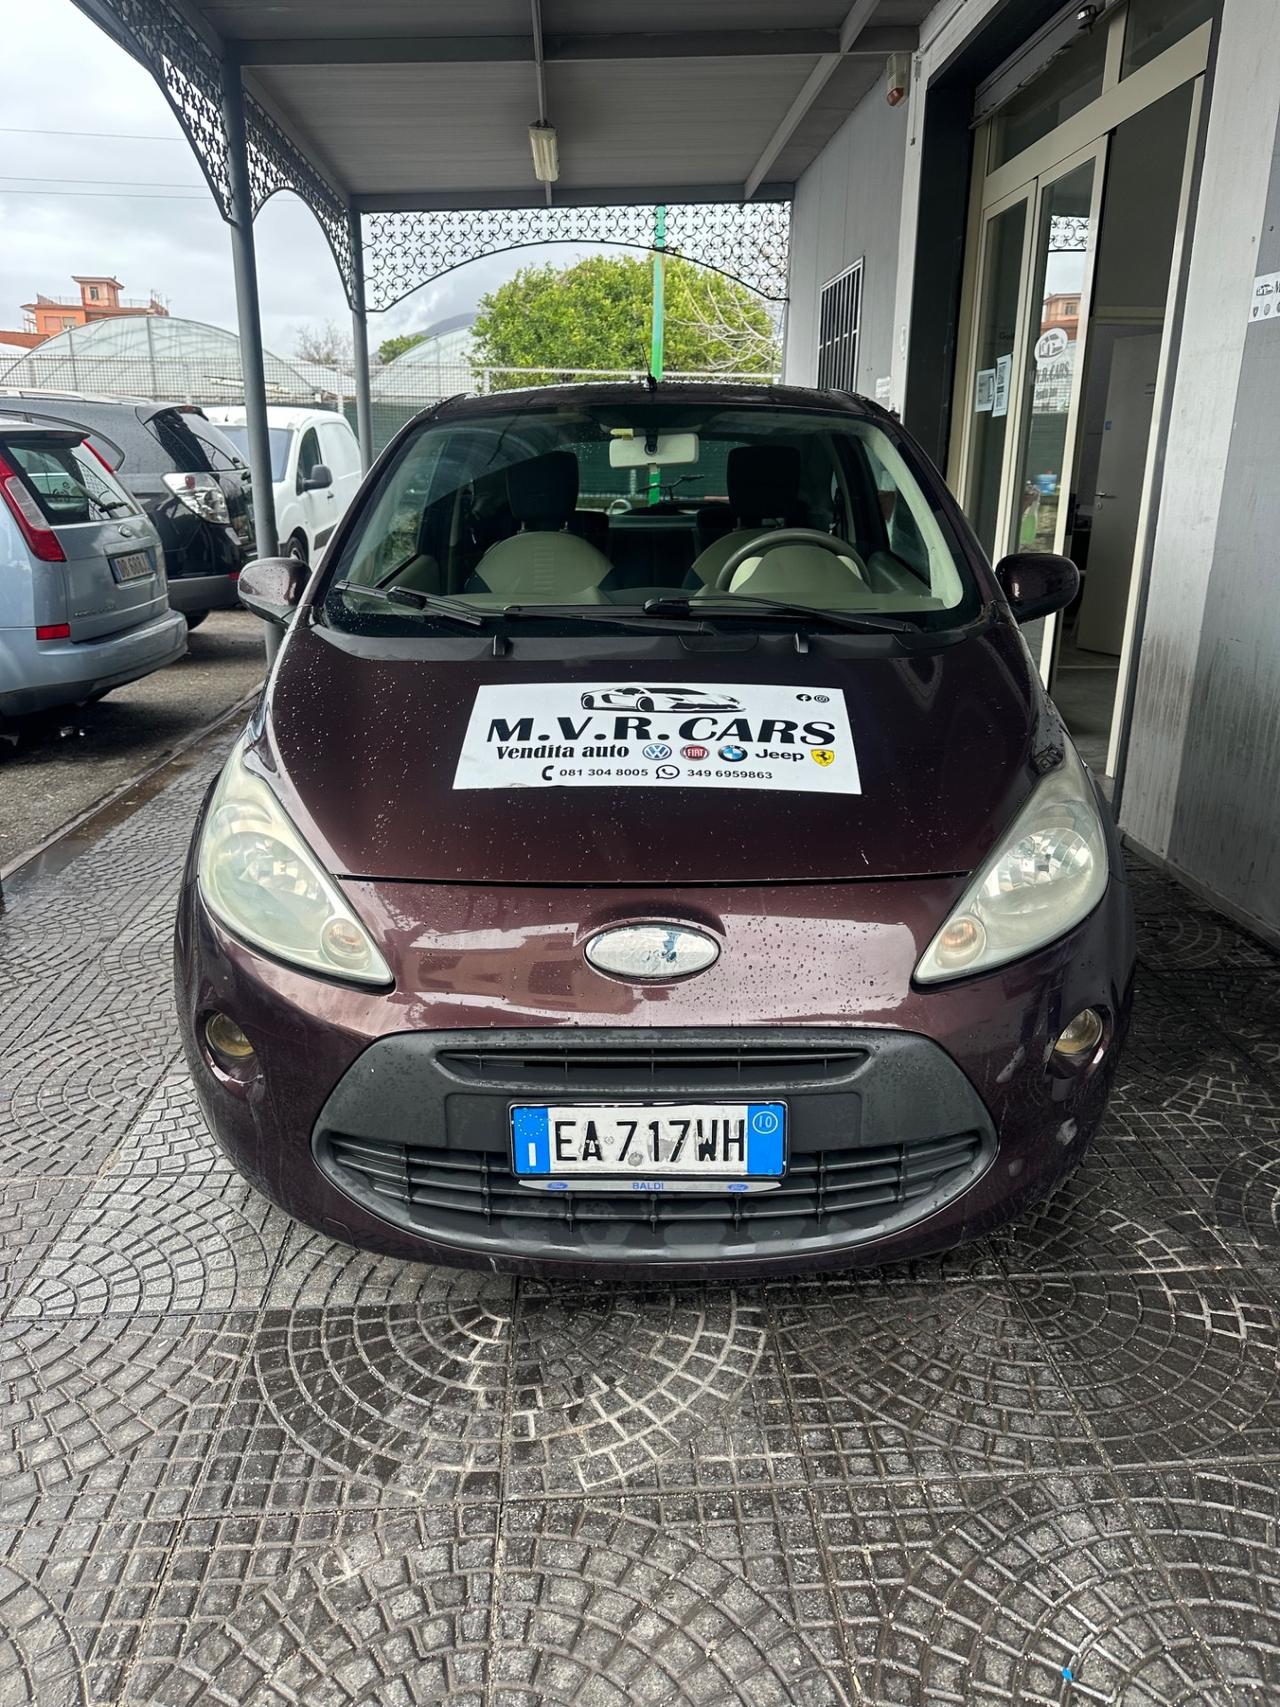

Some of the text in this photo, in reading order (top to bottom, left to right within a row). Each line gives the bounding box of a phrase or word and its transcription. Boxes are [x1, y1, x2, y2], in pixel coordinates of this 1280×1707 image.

[496, 744, 575, 759] Vendita
[581, 744, 630, 758] auto
[687, 748, 704, 757] FIAT
[755, 748, 805, 762] Jeep
[559, 768, 773, 779] 081 304 8005 349 6959863
[758, 1115, 773, 1128] 10
[632, 1182, 664, 1190] BALDI
